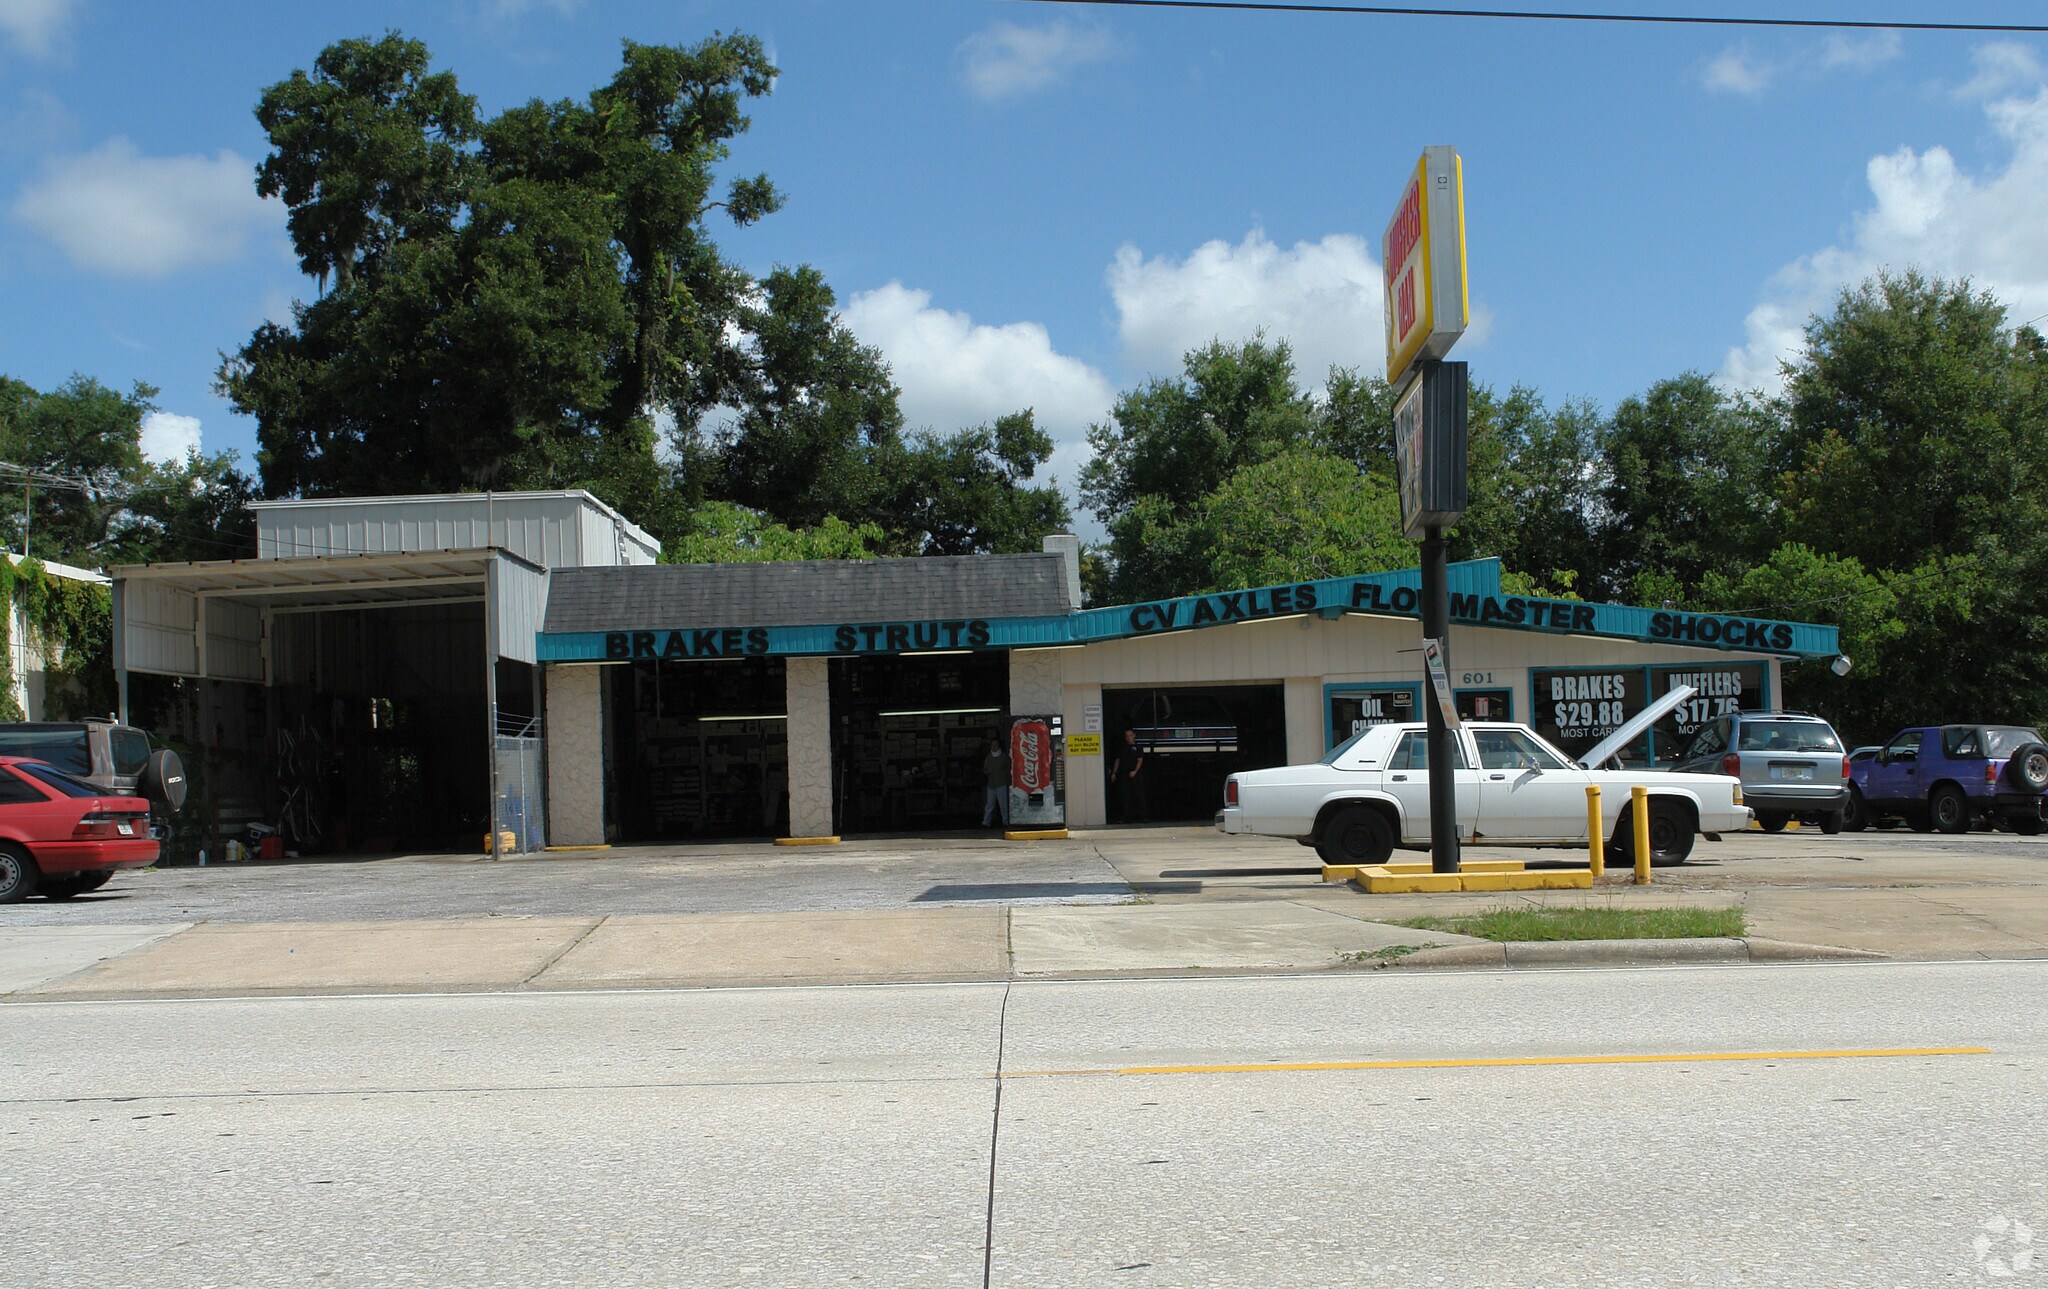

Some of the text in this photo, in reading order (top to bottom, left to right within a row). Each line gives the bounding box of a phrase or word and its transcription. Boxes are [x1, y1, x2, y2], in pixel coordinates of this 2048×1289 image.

[1389, 179, 1421, 286] MUFFLER
[1130, 584, 1317, 631] CV AXLES
[1352, 583, 1596, 631] FLOMASTER
[606, 628, 769, 658] BRAKES
[834, 619, 990, 650] STRUTS
[1650, 612, 1793, 650] SHOCKS
[1463, 672, 1493, 684] 601
[1551, 675, 1625, 700] BRAKES
[1669, 672, 1742, 696] MUFFLERS
[1362, 698, 1384, 717] OIL
[1555, 701, 1624, 728] $29.88
[1674, 697, 1739, 725] $17.76
[1560, 728, 1589, 738] MOST
[1678, 725, 1700, 734] MOS
